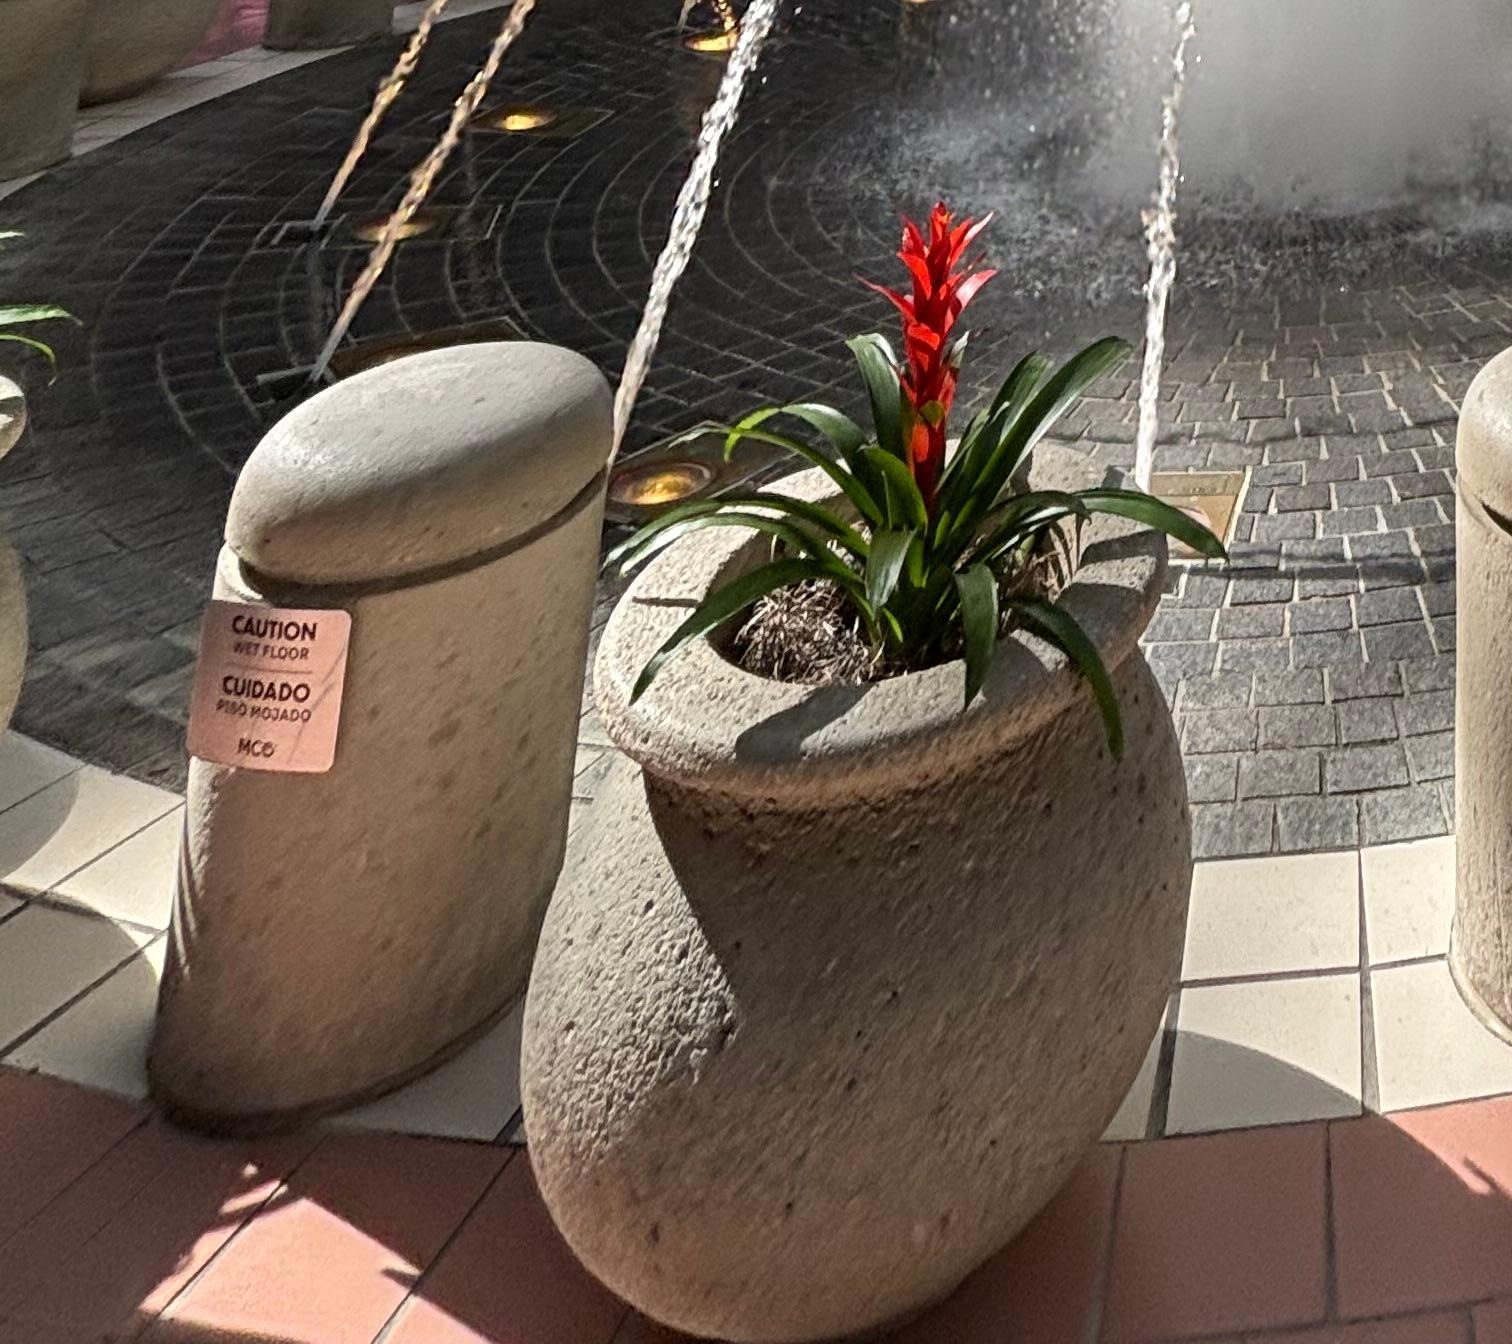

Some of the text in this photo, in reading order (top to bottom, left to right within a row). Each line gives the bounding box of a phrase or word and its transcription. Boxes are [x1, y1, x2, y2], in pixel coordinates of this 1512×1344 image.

[231, 615, 318, 642] CAUTION
[233, 642, 309, 661] WET FLOOR
[222, 676, 311, 703] CUIDADO
[216, 700, 312, 723] PISO MOJADO
[237, 738, 275, 758] MCO
